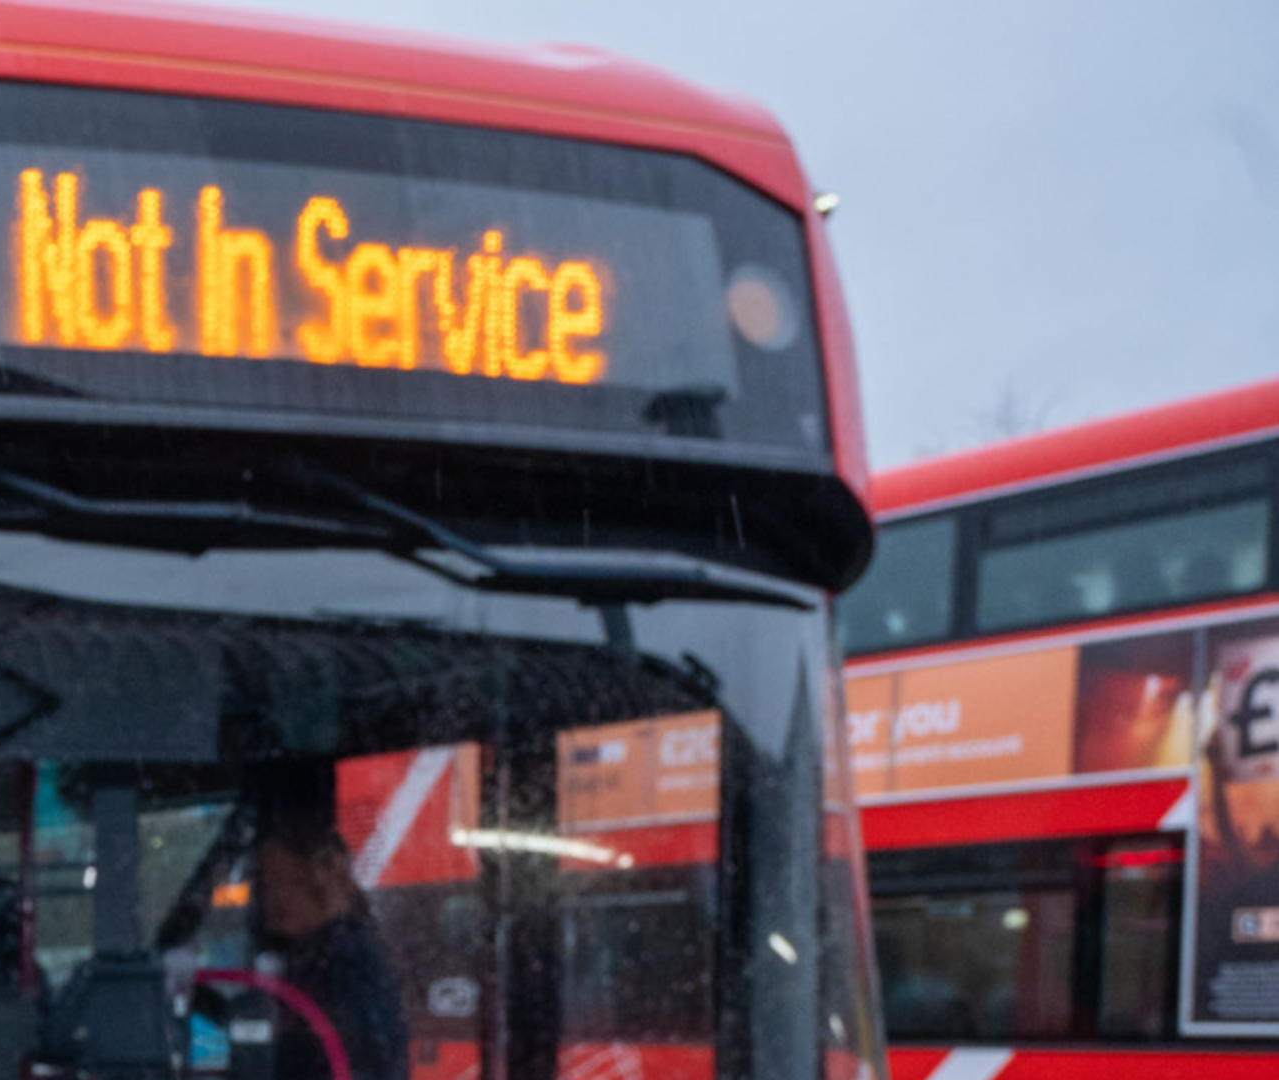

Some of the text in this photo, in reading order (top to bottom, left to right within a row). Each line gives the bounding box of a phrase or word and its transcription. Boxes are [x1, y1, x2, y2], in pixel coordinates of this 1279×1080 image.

[15, 166, 606, 386] Not In Service
[891, 697, 961, 745] you
